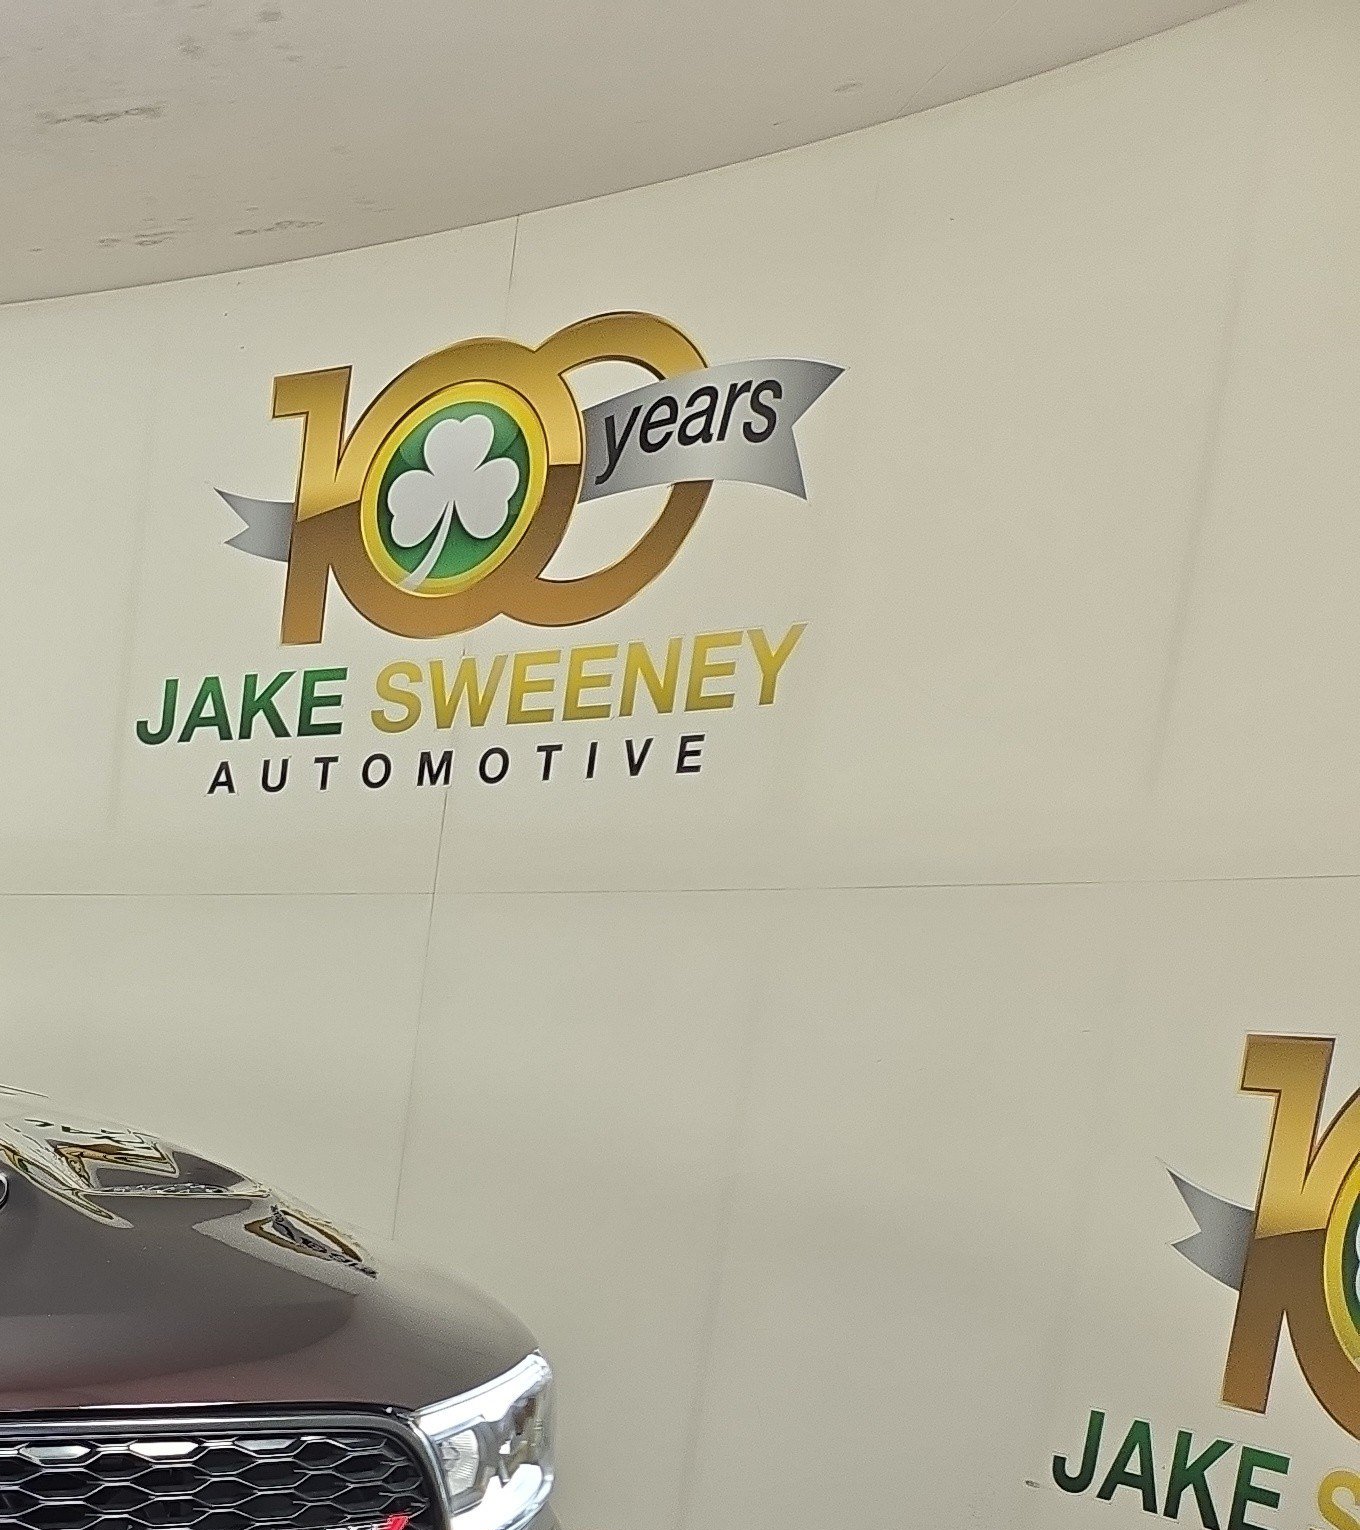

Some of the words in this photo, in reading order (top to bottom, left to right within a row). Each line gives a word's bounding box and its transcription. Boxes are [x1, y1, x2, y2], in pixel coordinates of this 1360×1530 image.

[594, 377, 782, 484] years
[136, 666, 349, 744] JAKE
[371, 622, 808, 734] SWEENEY
[207, 734, 706, 796] AUTOMOTIVE
